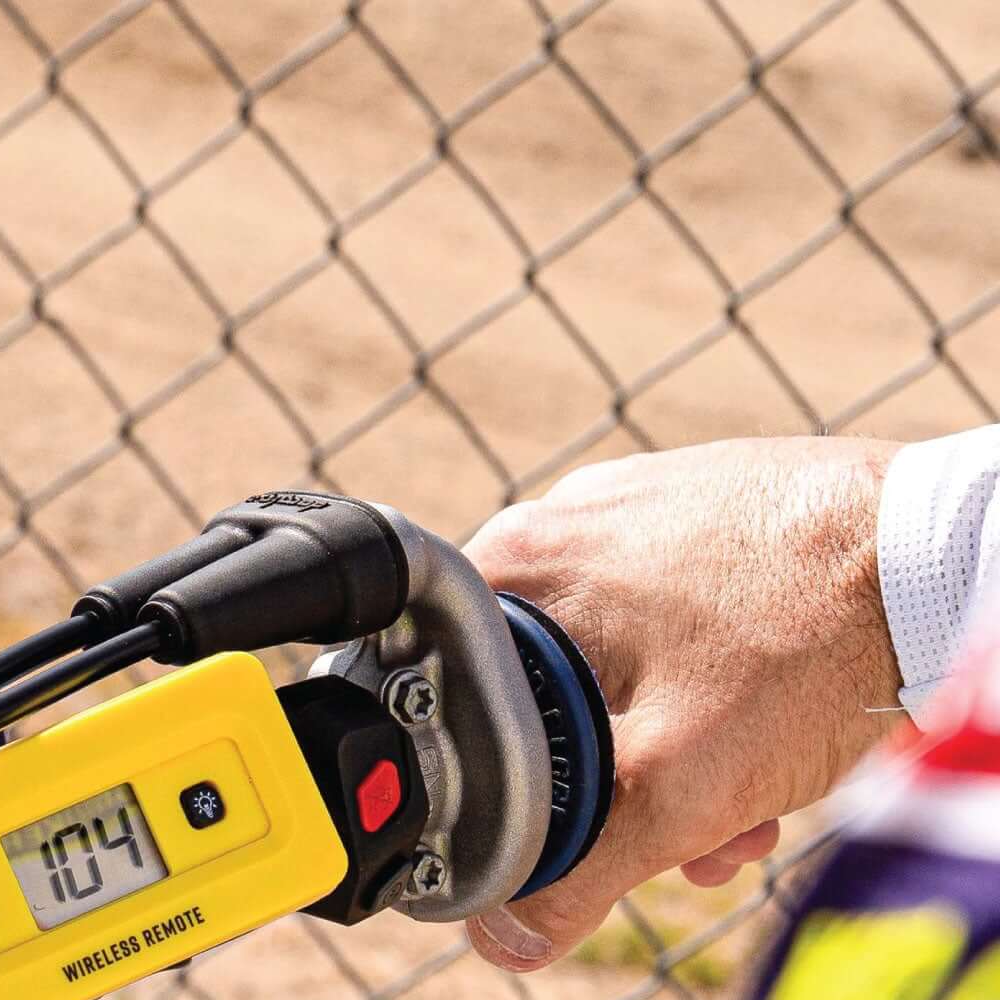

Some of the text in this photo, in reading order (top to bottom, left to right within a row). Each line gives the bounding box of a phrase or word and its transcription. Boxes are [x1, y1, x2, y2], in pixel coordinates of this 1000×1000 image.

[40, 806, 144, 904] 104
[62, 906, 206, 983] WIRELESS REMOTE
